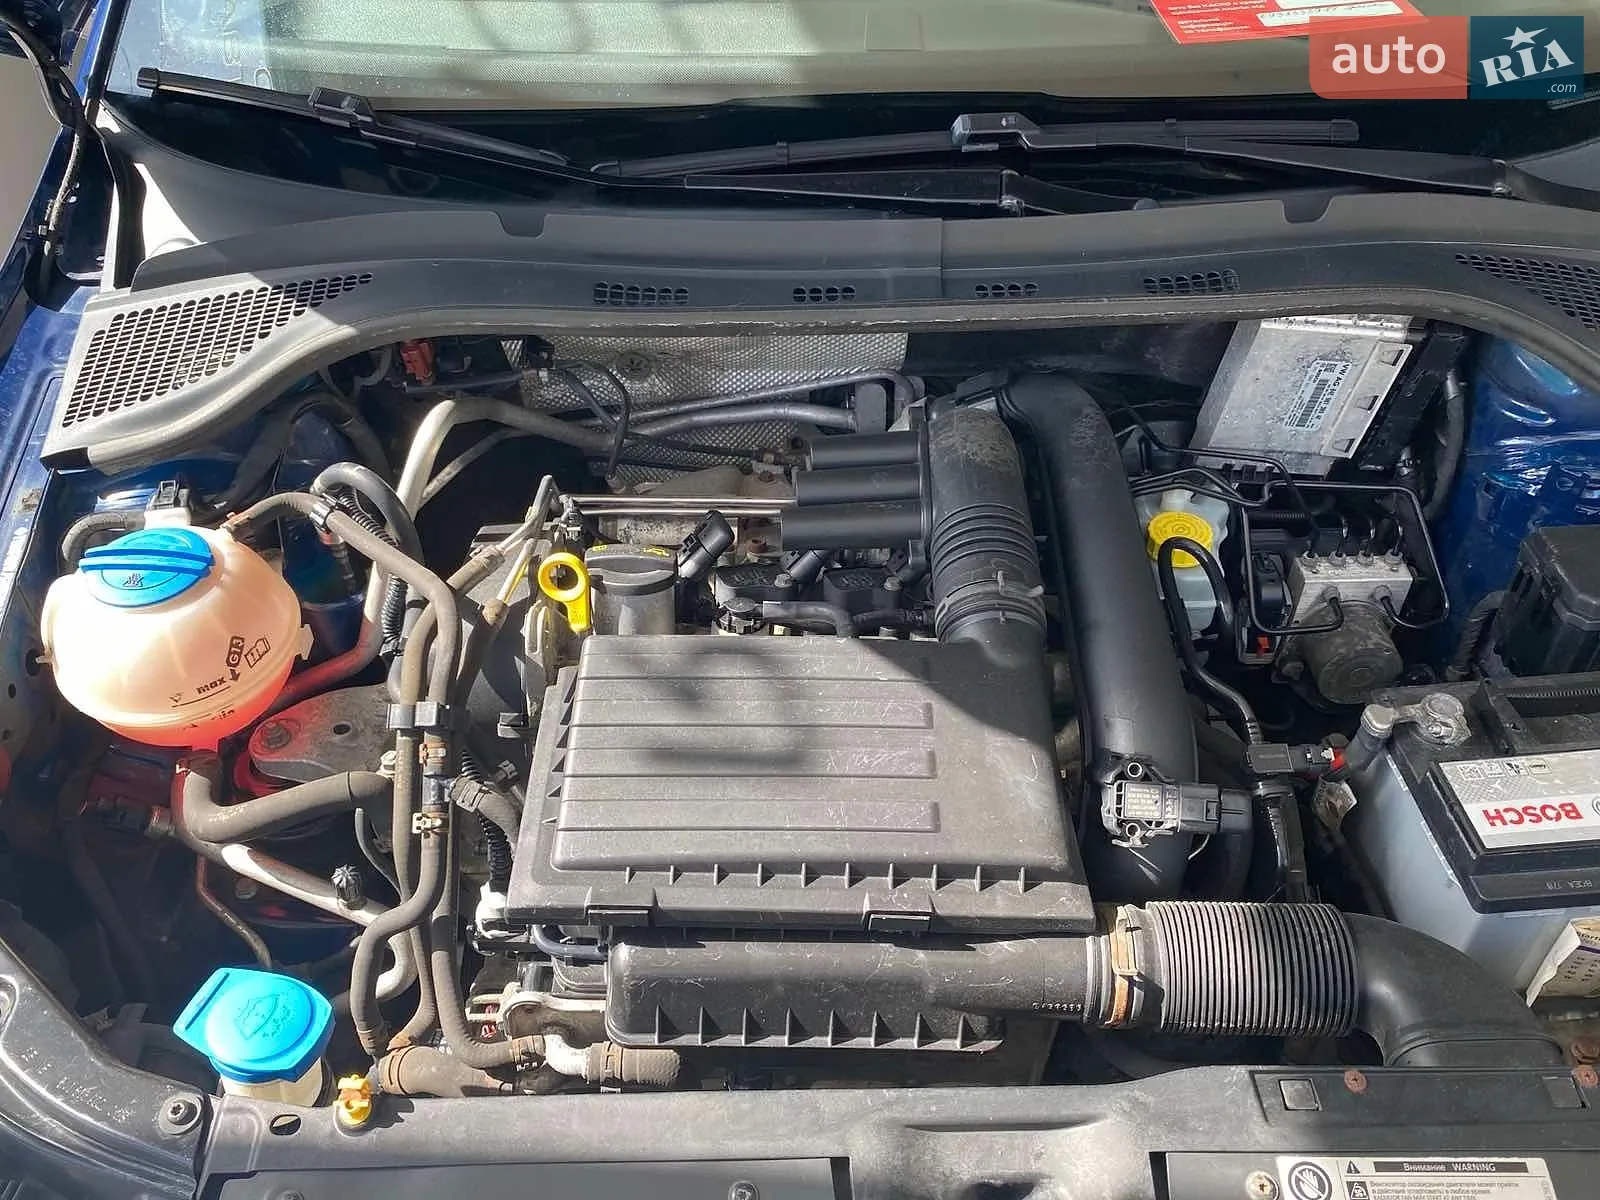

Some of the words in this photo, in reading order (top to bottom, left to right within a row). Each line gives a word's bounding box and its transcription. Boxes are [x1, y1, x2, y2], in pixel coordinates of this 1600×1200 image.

[196, 676, 226, 694] max
[1482, 802, 1584, 827] BOSCH
[1451, 1162, 1496, 1172] WARNING
